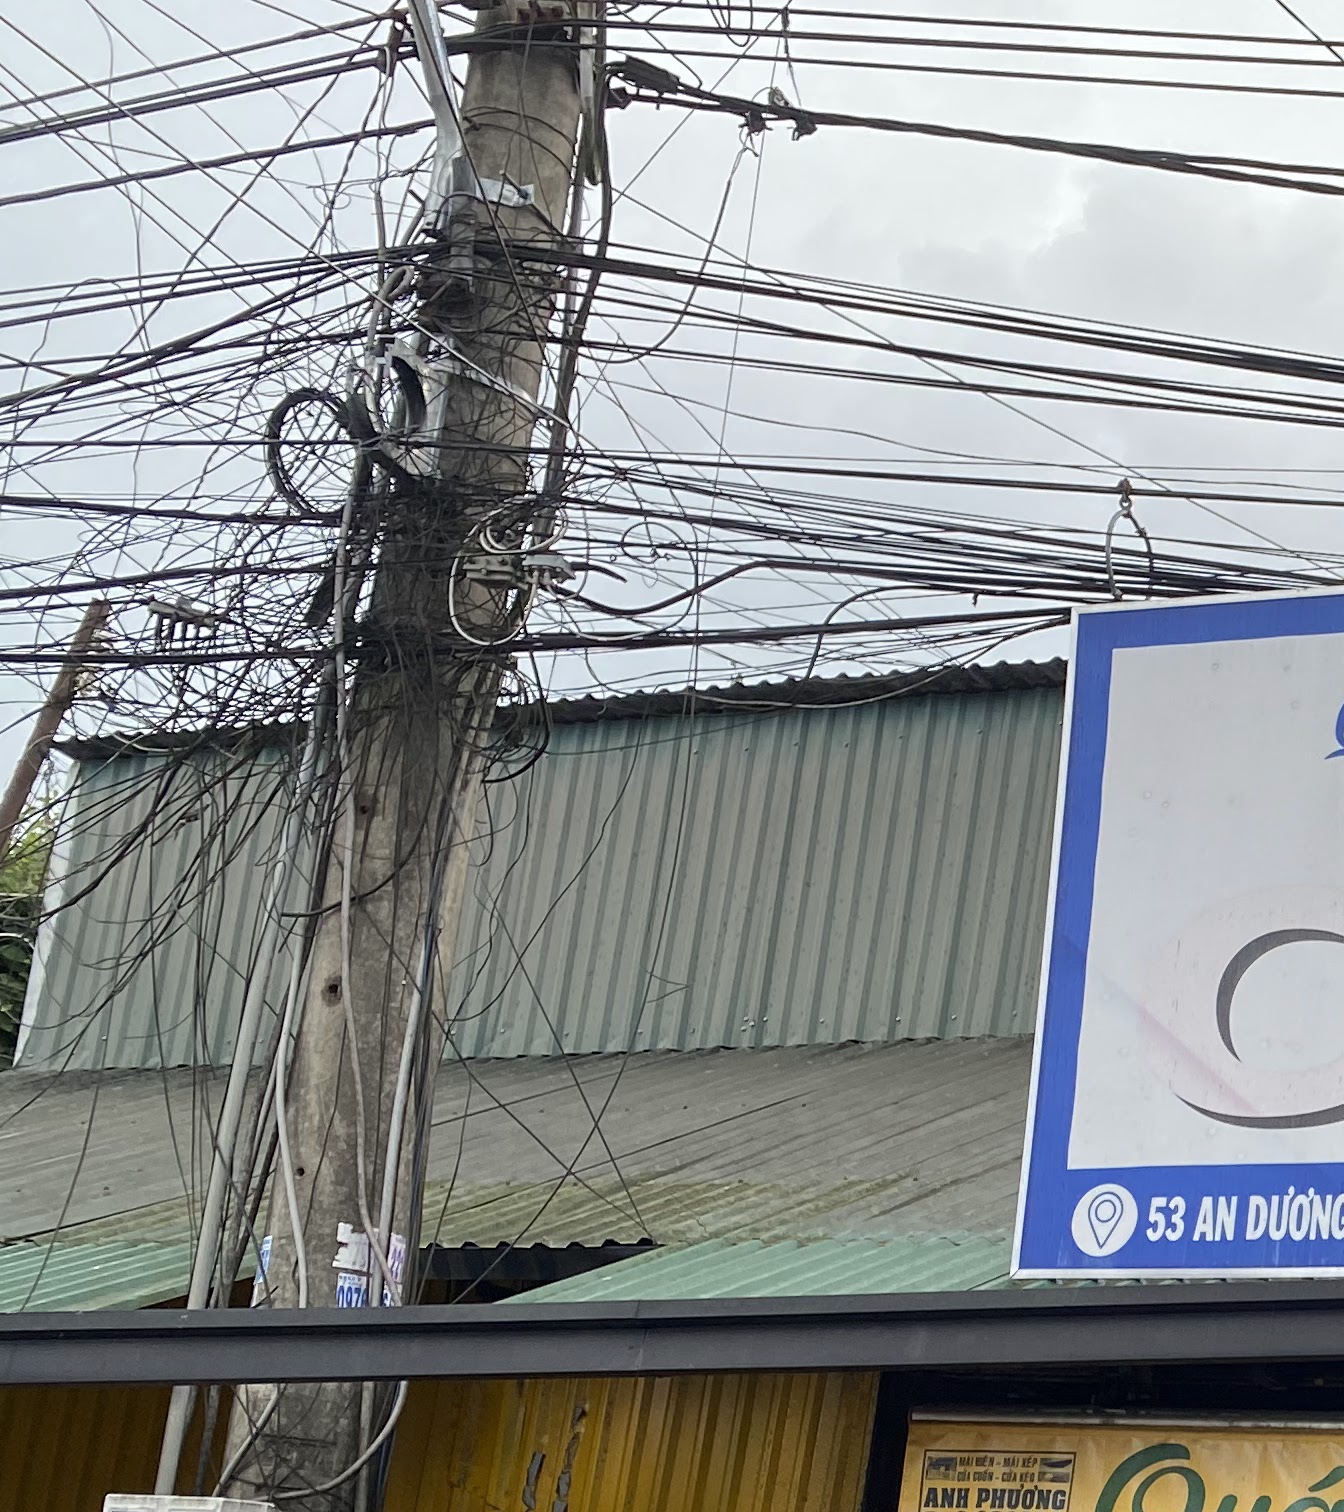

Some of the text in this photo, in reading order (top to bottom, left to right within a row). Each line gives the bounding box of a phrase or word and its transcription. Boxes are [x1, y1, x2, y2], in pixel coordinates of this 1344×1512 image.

[1146, 1195, 1186, 1242] 53
[1193, 1195, 1239, 1242] AN
[923, 1484, 1067, 1510] ANH PHƯƠNG
